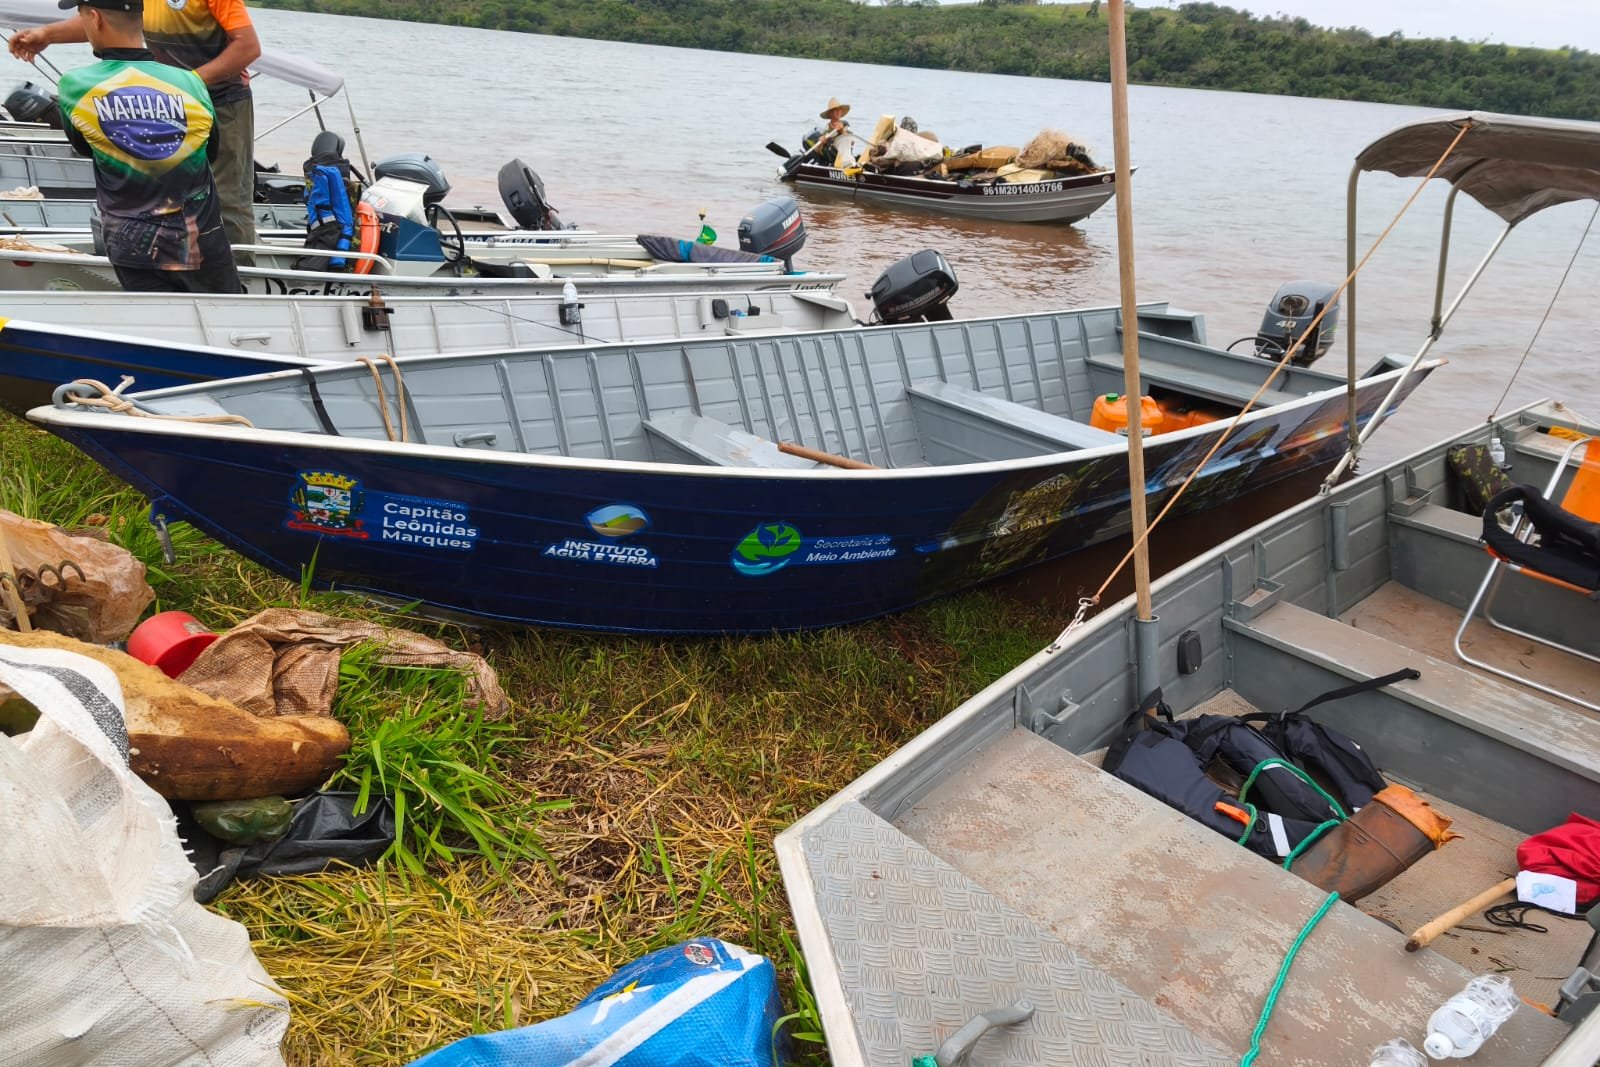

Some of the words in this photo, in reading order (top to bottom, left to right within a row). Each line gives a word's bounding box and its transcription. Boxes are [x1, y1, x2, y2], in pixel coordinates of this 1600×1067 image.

[93, 94, 185, 121] NATHAN
[983, 182, 1063, 196] 961M2014003766
[383, 502, 466, 521] Capitão
[383, 516, 478, 537] Leônidas
[382, 529, 472, 549] Marques
[564, 540, 648, 557] INSTITUTO
[544, 545, 590, 560] ÁGUA
[594, 552, 606, 561] E
[608, 554, 657, 566] TERRA
[805, 552, 838, 562] Meio
[840, 548, 897, 561] Ambiente
